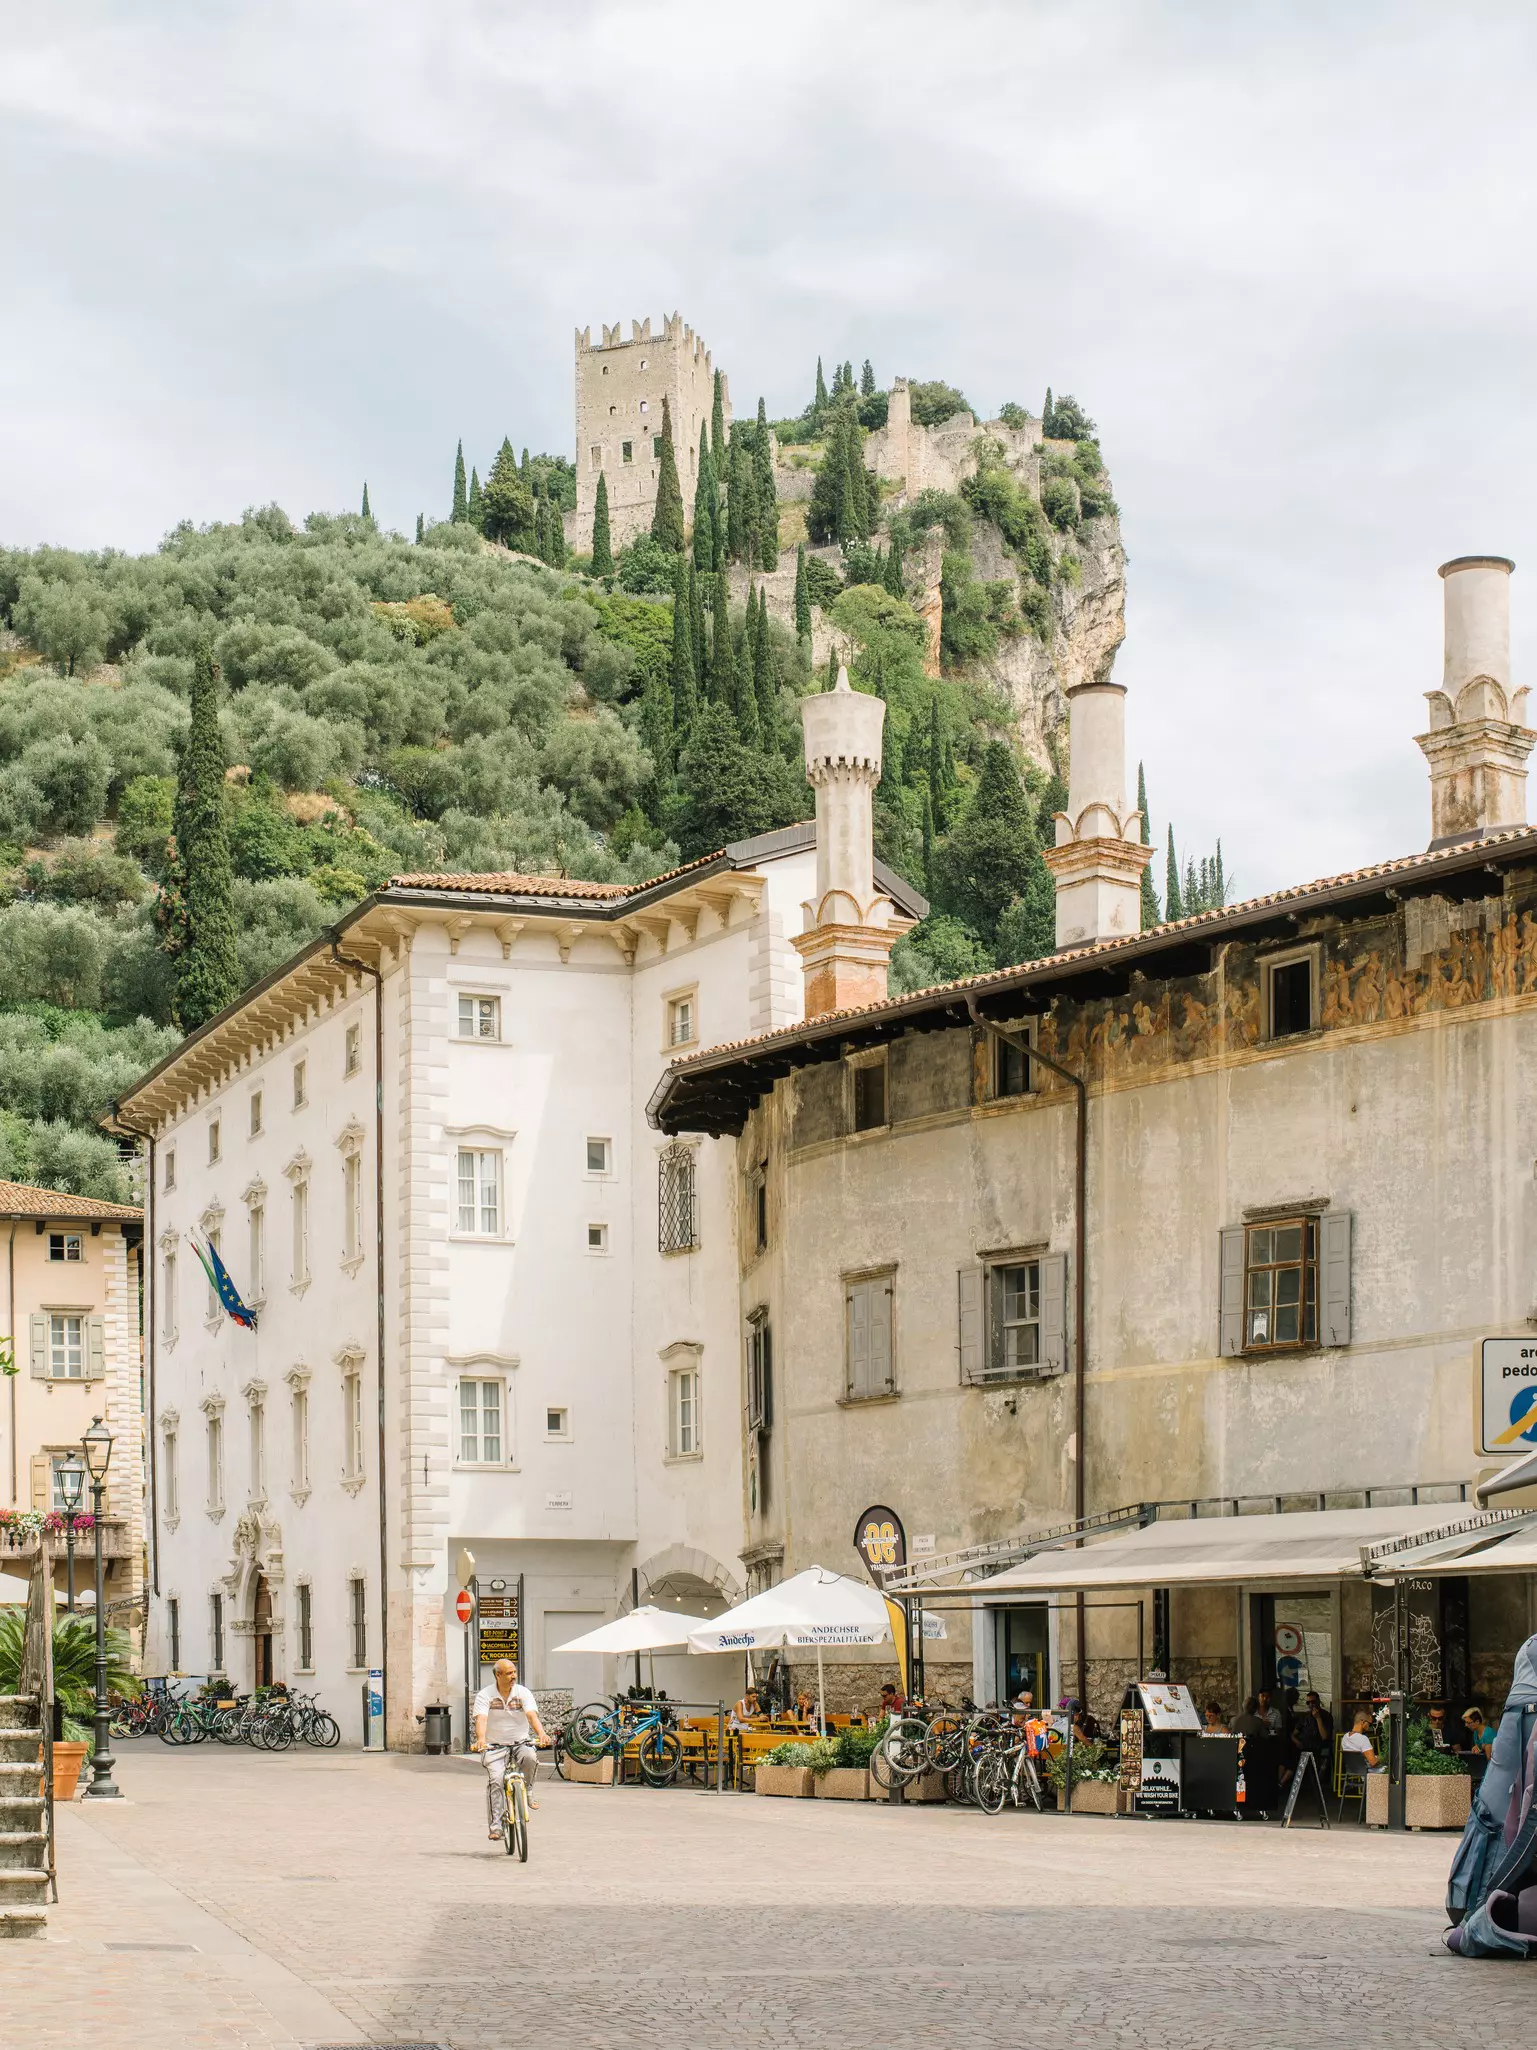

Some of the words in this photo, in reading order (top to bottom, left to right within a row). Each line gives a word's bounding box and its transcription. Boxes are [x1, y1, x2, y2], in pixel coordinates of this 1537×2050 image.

[1409, 1580, 1433, 1591] ARCO
[811, 1626, 860, 1634] ANDECHSER
[718, 1632, 755, 1647] Andechs
[797, 1634, 874, 1644] BIERSPEZIALITÄTEN
